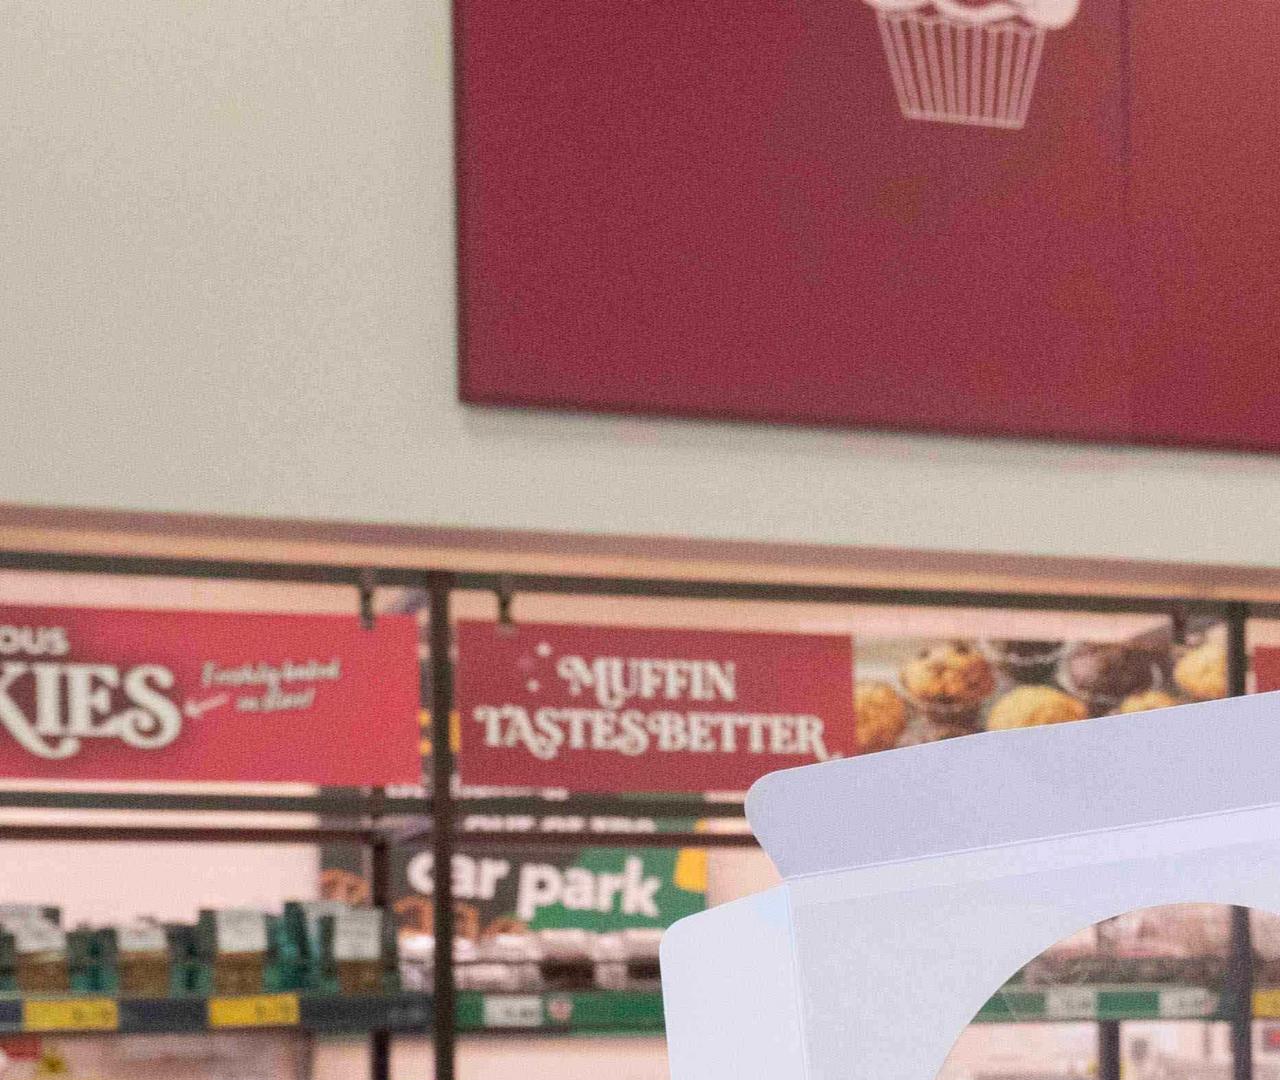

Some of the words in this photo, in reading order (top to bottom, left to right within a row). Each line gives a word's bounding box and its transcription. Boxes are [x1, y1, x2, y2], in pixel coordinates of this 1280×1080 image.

[556, 654, 737, 710] MUFFIN
[406, 851, 511, 901] car
[516, 855, 662, 922] park
